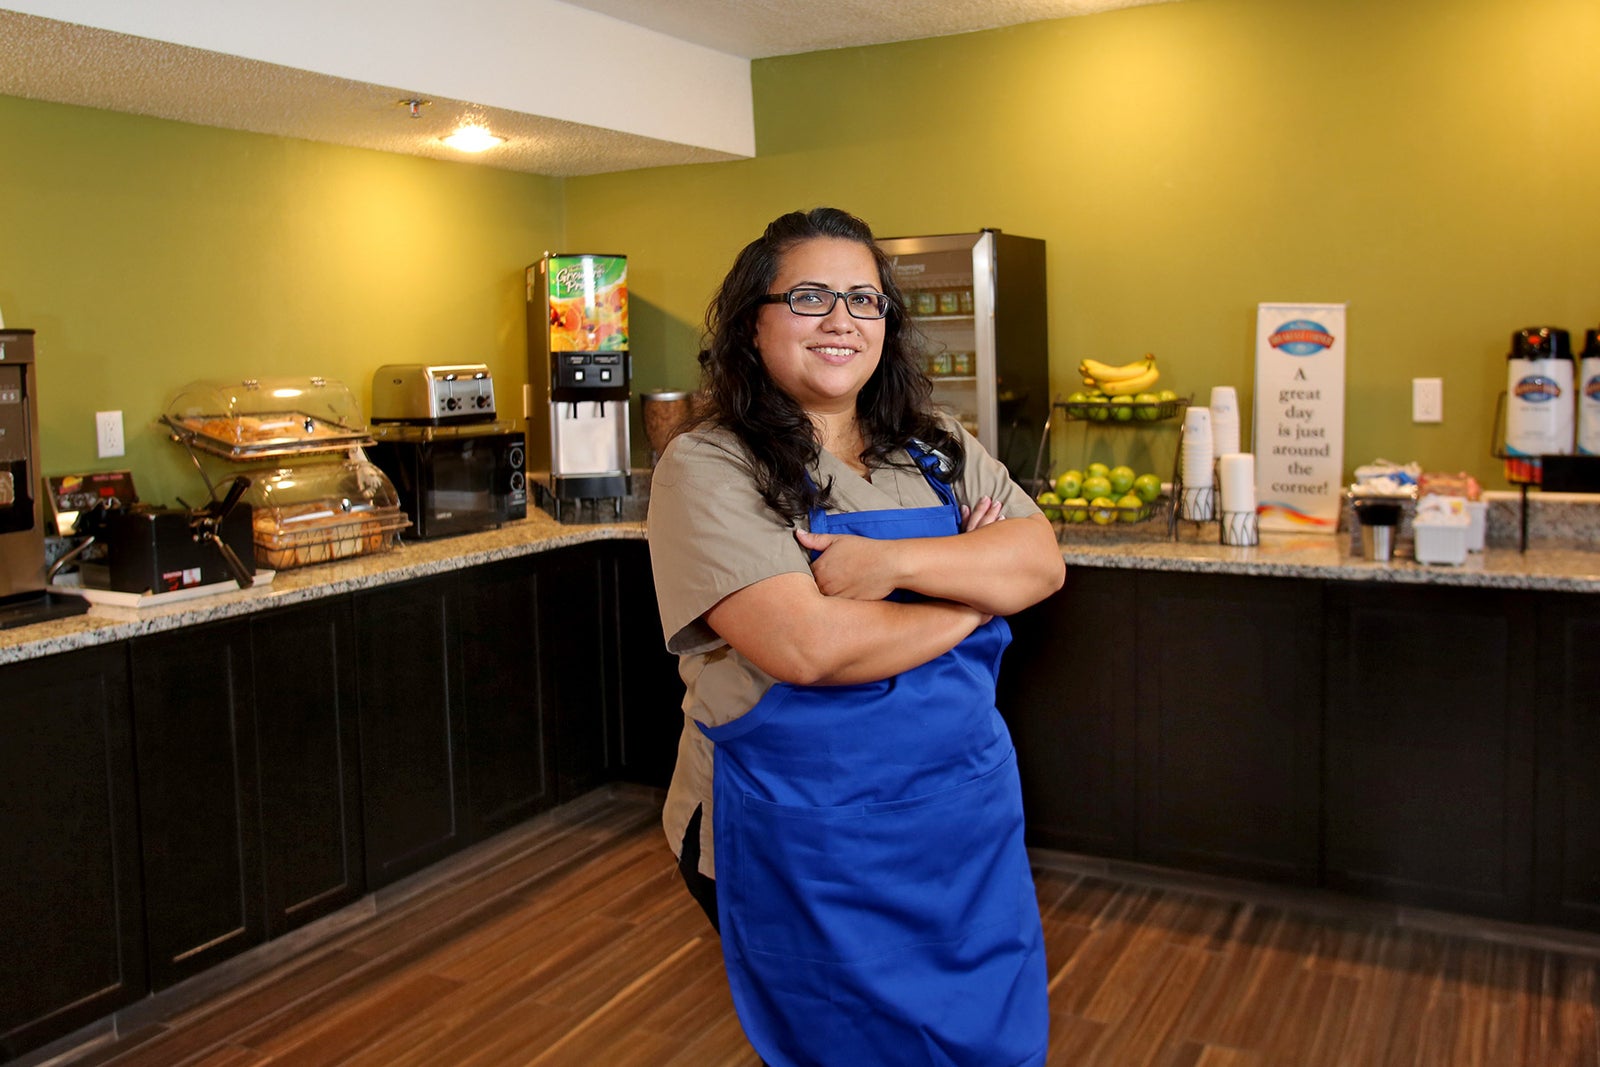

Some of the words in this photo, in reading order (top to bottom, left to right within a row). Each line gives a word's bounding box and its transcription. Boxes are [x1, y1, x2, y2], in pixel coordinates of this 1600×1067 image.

[1294, 367, 1306, 381] A
[1278, 389, 1321, 404] great
[1285, 405, 1314, 423] day
[1278, 422, 1291, 437] is
[1295, 422, 1326, 441] just
[1272, 443, 1330, 458] around
[1288, 461, 1313, 476] the
[1271, 481, 1328, 496] corner!
